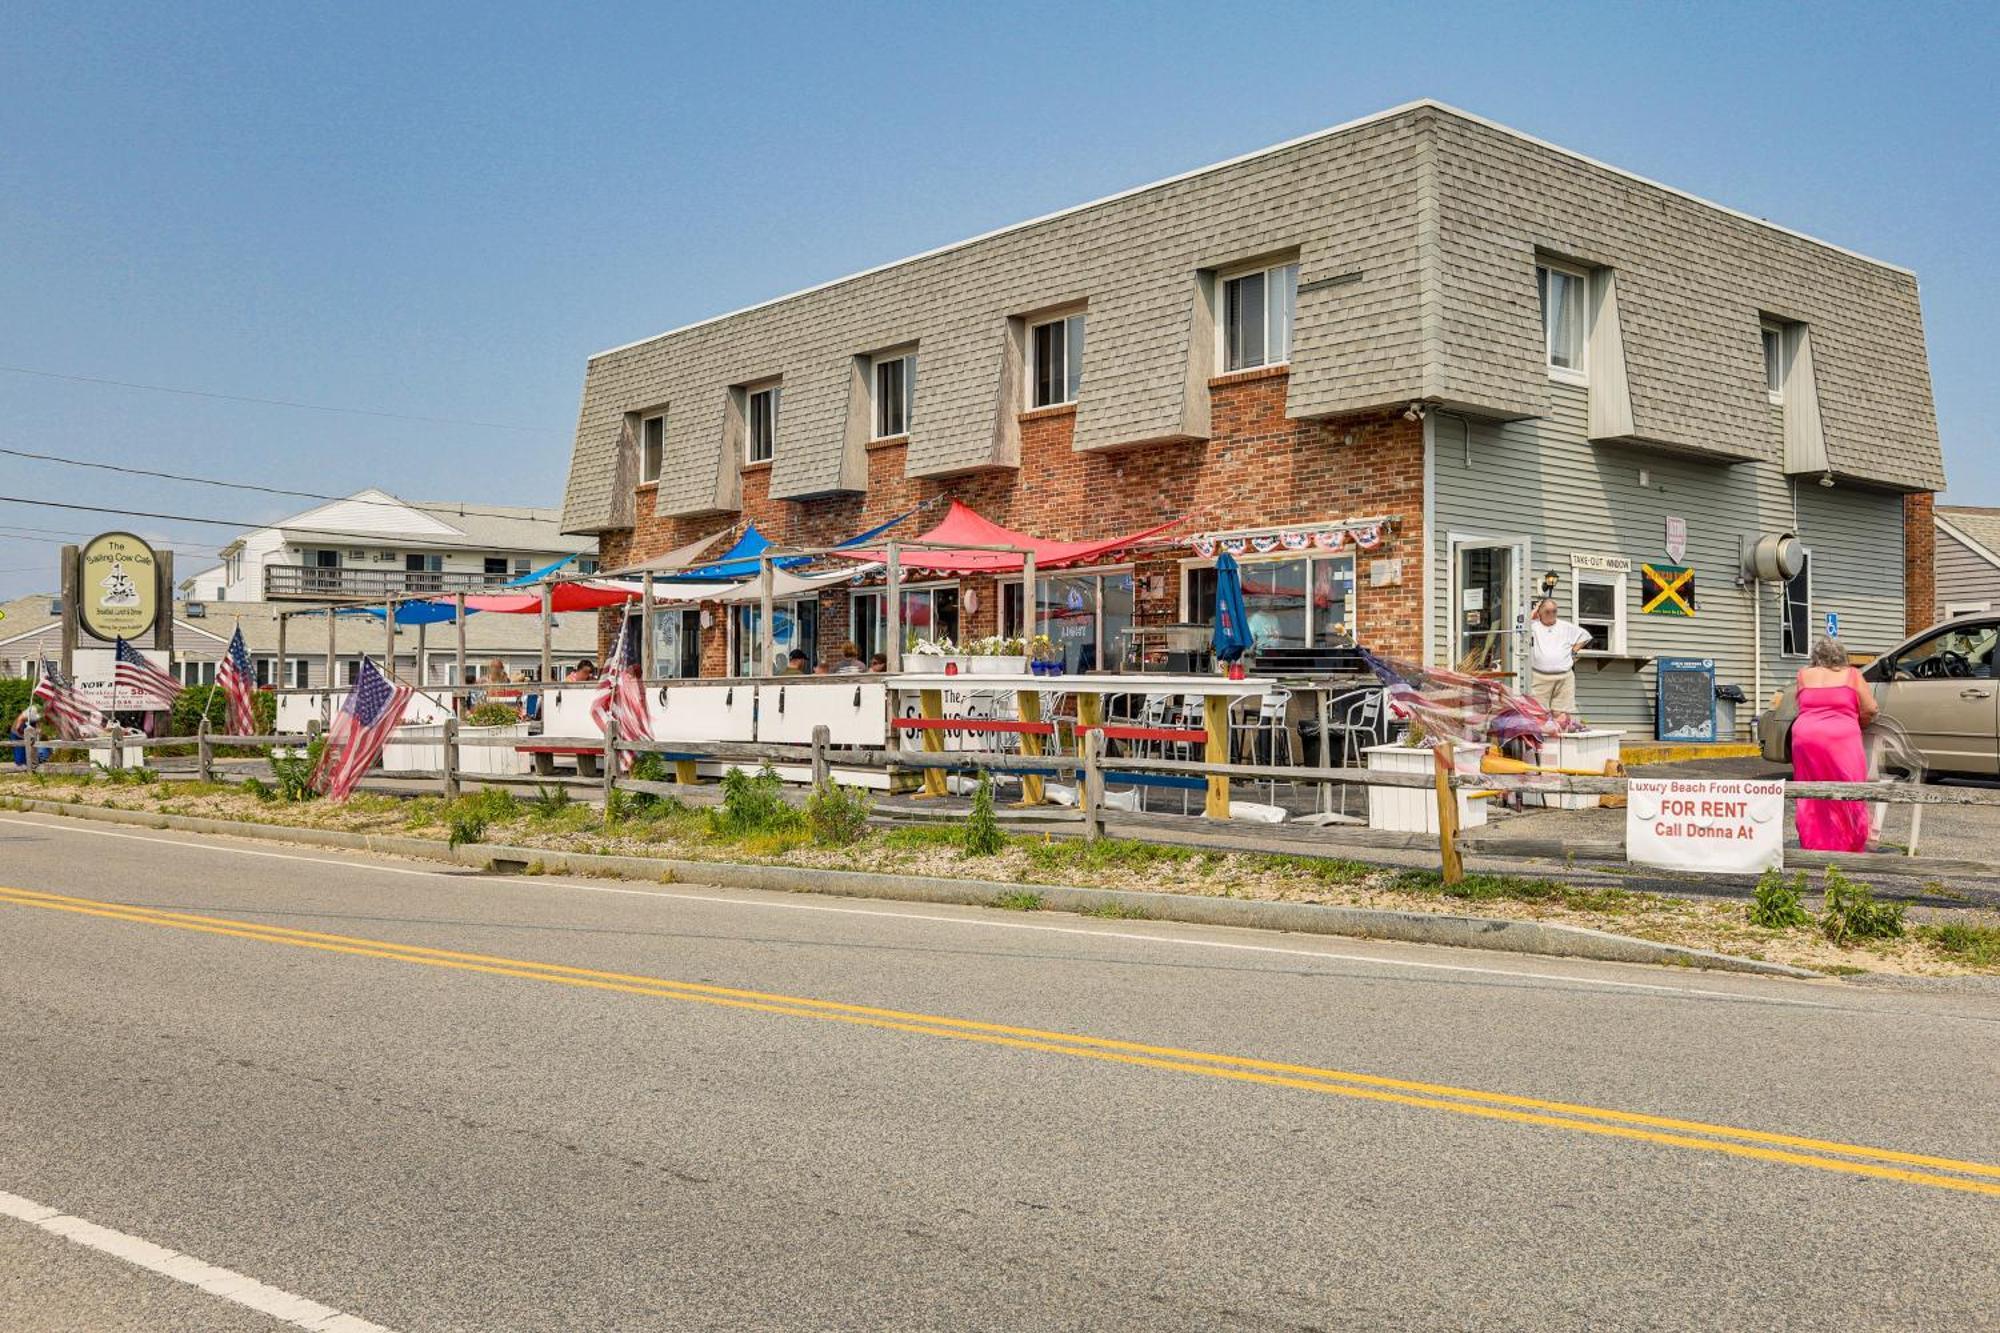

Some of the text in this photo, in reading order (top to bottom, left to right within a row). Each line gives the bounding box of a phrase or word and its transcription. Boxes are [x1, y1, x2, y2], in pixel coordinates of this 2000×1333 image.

[108, 541, 125, 551] The
[86, 554, 114, 564] Sailing
[115, 552, 133, 562] Cow
[1572, 555, 1629, 568] TAKE-OUT WINDOW
[80, 681, 104, 690] NOW
[944, 690, 961, 703] The
[1629, 781, 1783, 795] Luxury Beach Front Condo
[1661, 800, 1748, 818] FOR RENT
[1655, 822, 1753, 839] Call Donna At
